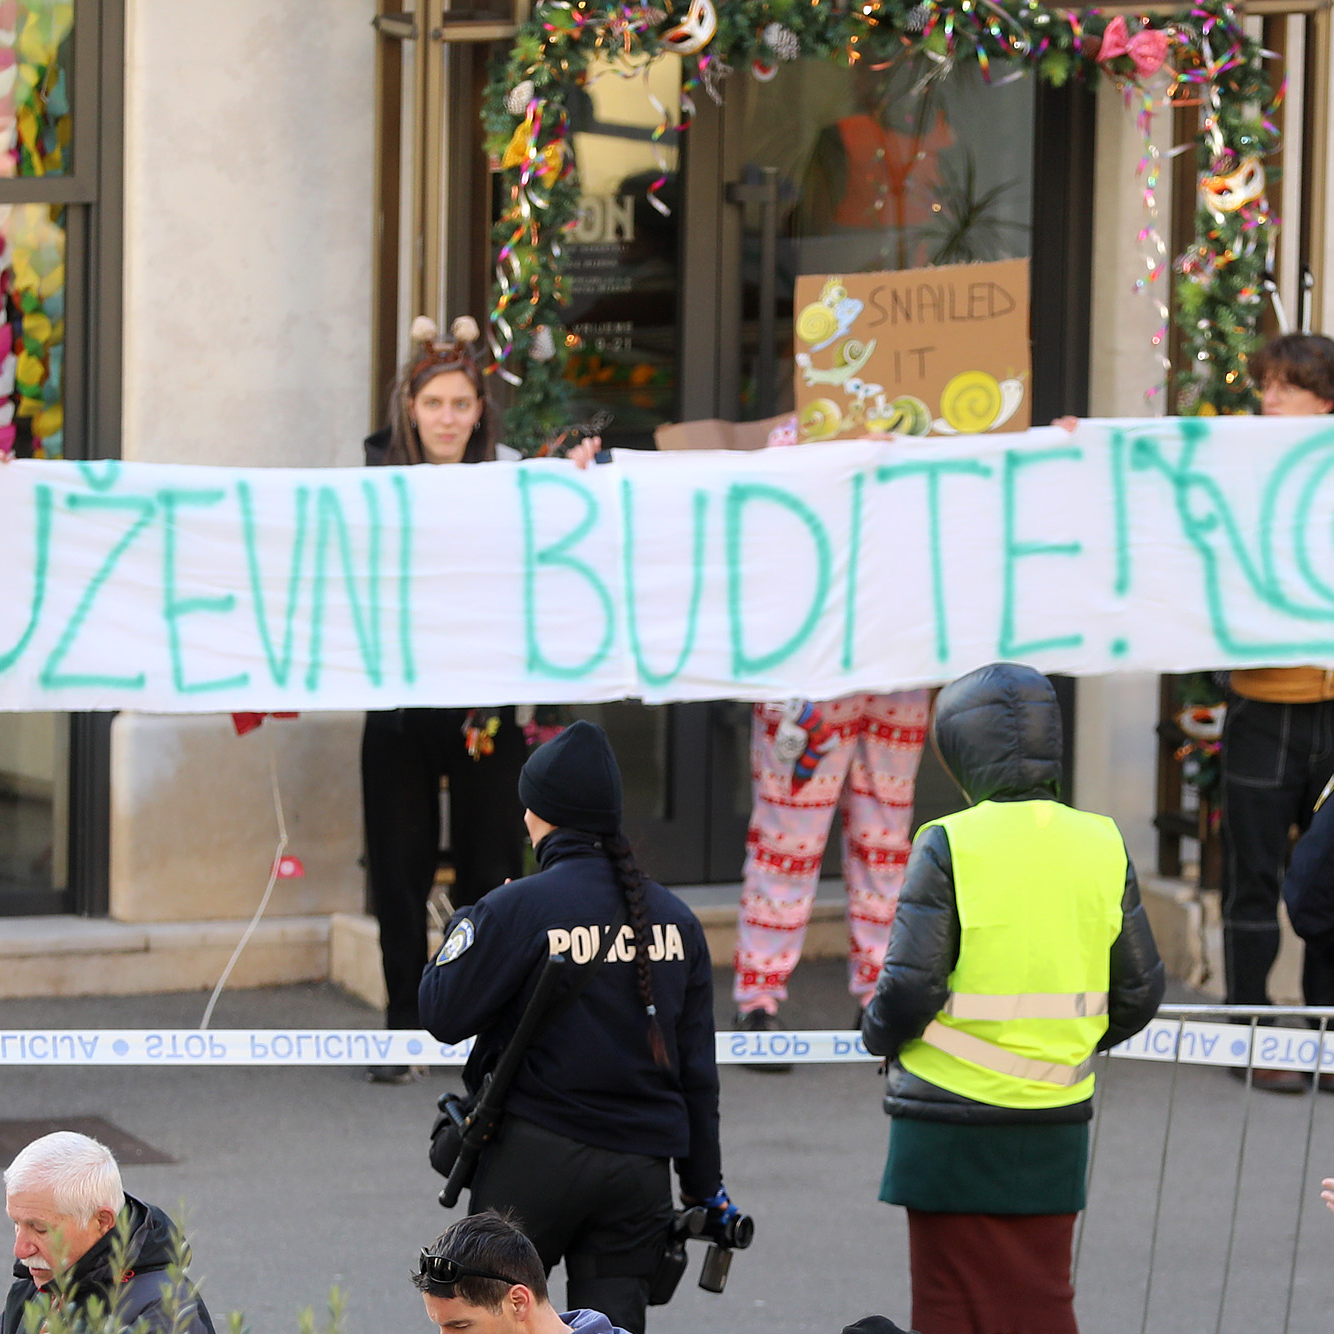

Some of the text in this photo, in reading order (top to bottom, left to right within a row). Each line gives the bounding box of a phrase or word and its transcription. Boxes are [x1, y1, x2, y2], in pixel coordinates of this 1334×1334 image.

[869, 281, 1016, 328] SNAILED
[894, 346, 937, 384] IT
[517, 430, 1131, 686] BUDITE!
[547, 923, 685, 965] POLCJA
